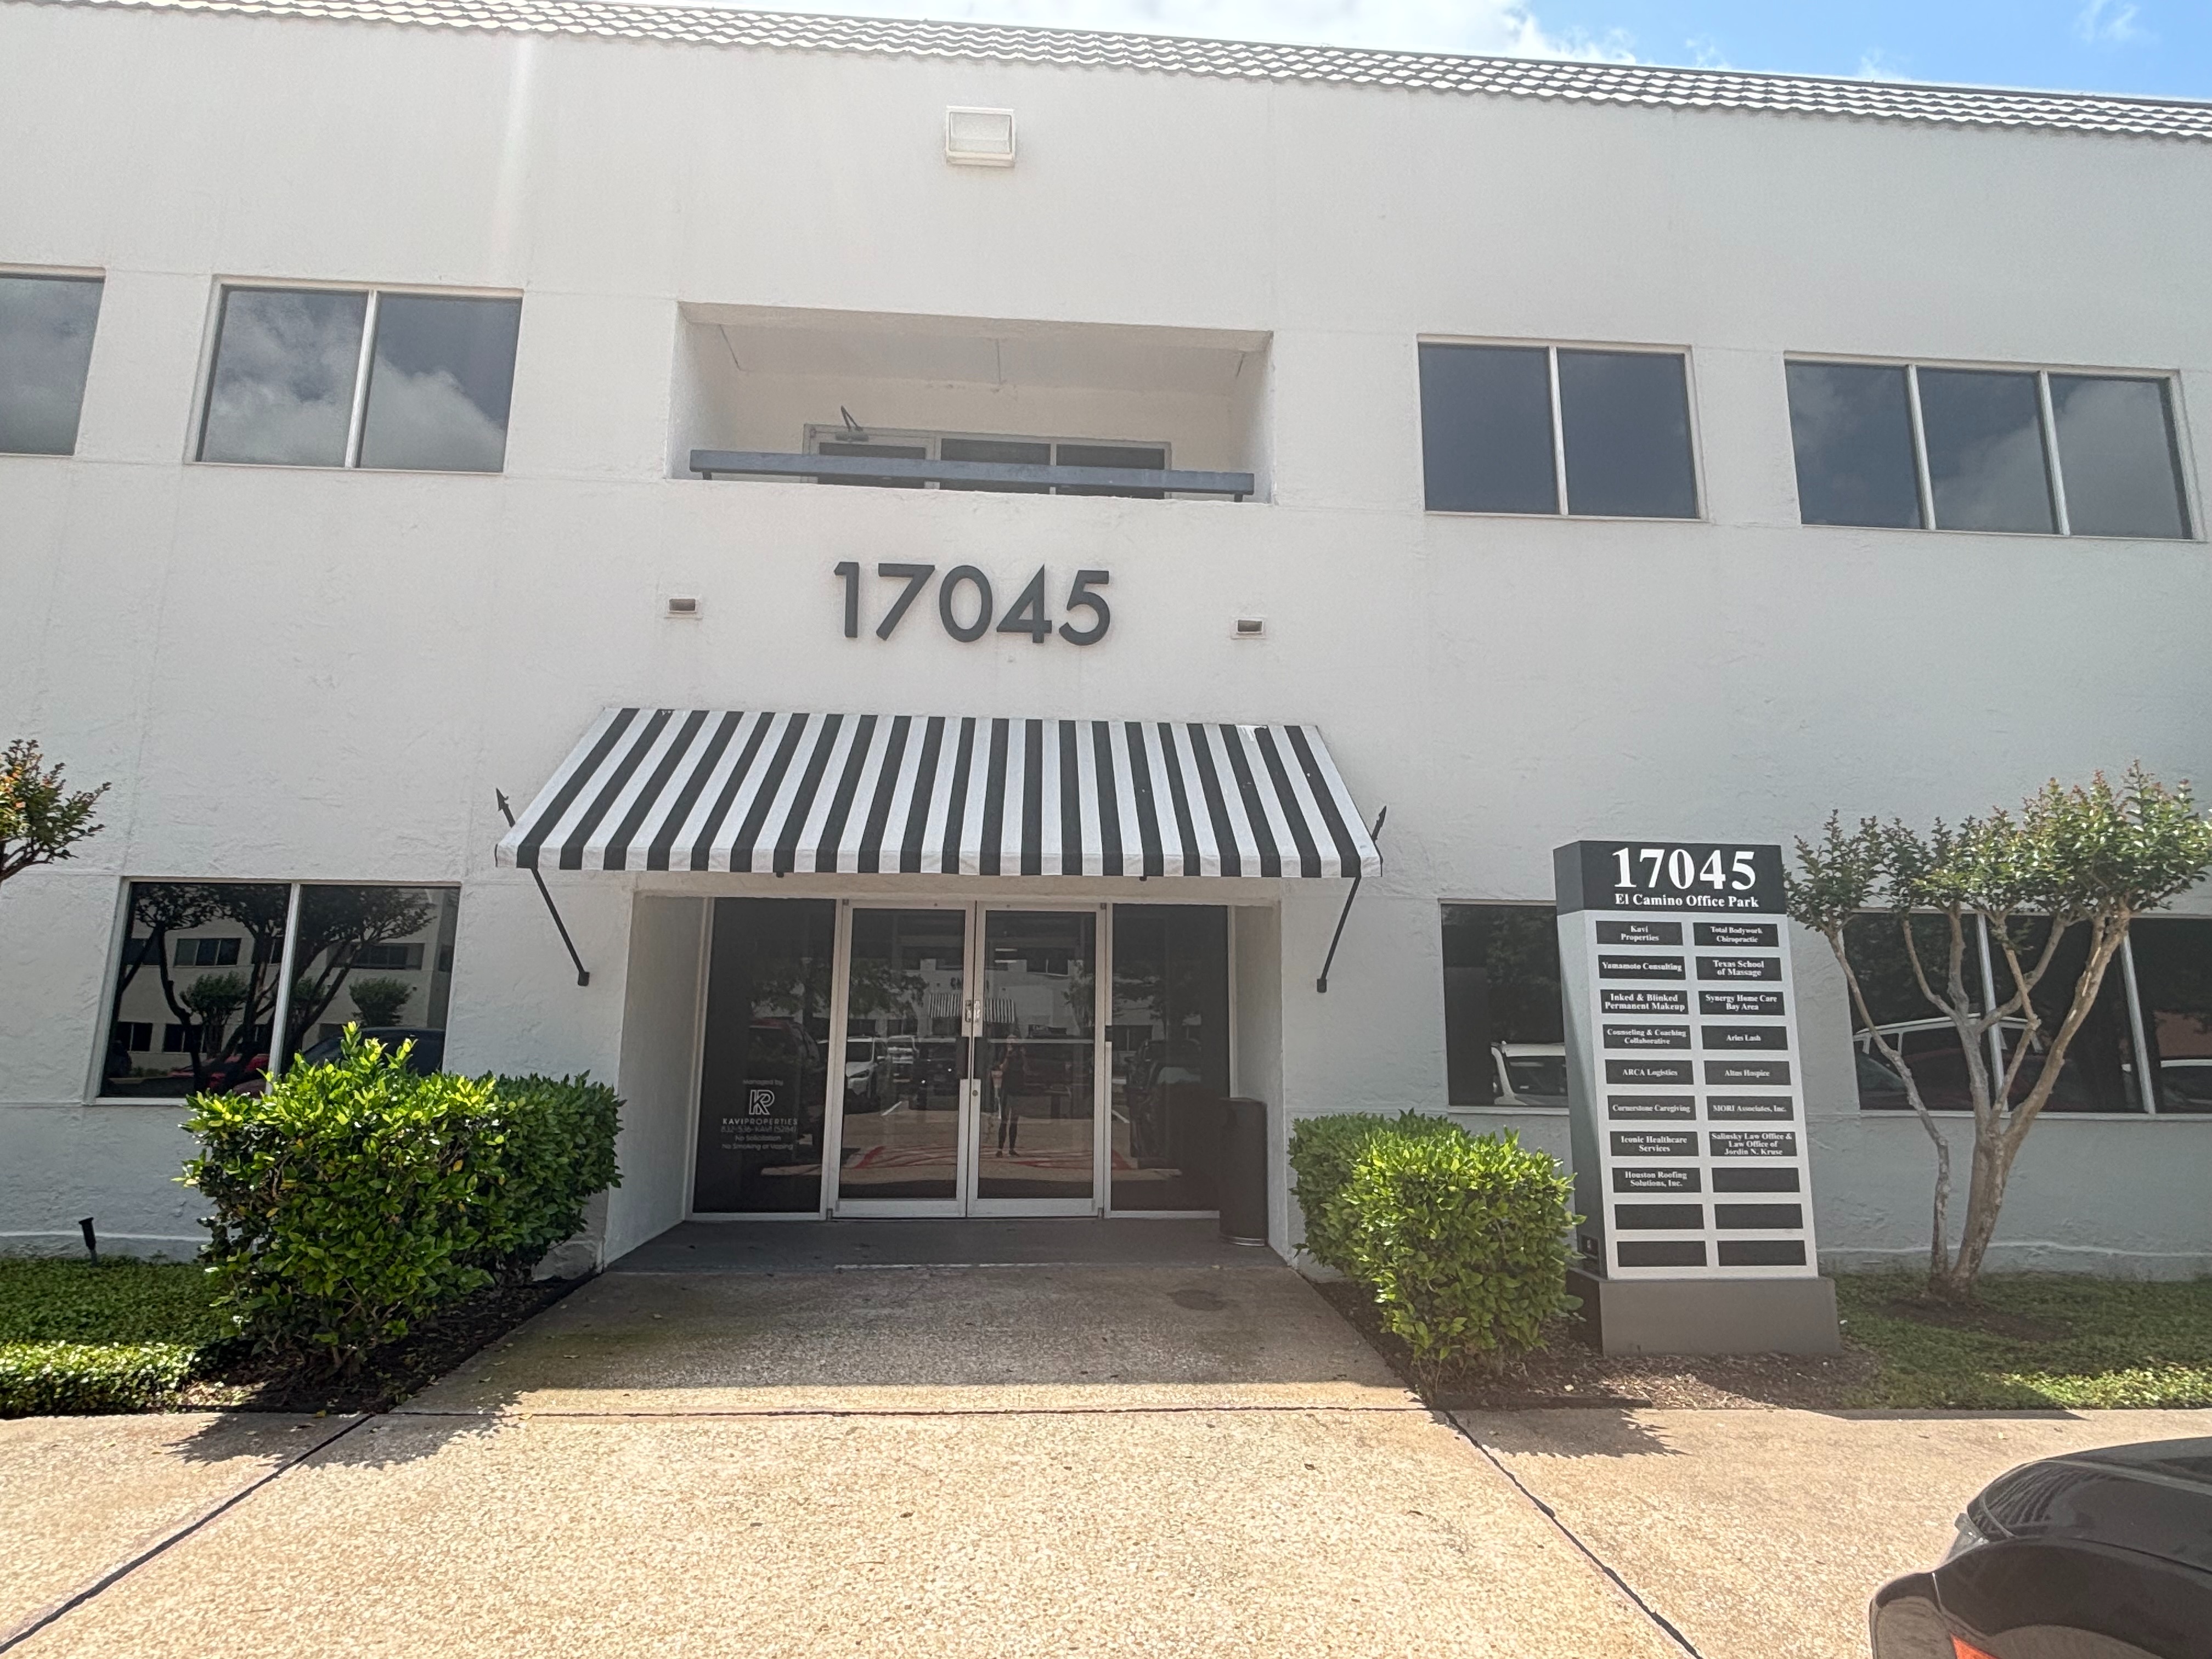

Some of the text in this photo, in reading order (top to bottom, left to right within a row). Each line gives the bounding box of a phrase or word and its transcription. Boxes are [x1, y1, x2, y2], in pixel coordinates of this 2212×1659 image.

[834, 562, 1110, 646] 17045
[1612, 847, 1756, 890] 17045
[1615, 894, 1759, 907] El Camino Office Park
[1729, 927, 1763, 935] Bodywork
[1621, 933, 1659, 942] Properties
[1716, 935, 1758, 944] Chiropractic
[1643, 963, 1682, 972] Consulting
[1728, 969, 1762, 977] Massage
[1651, 1002, 1685, 1012] Makeup
[1726, 1003, 1740, 1011] Bay
[1607, 1029, 1645, 1037] Counseling
[1654, 1104, 1691, 1113] Caregiving
[1658, 1171, 1688, 1180] Roofing
